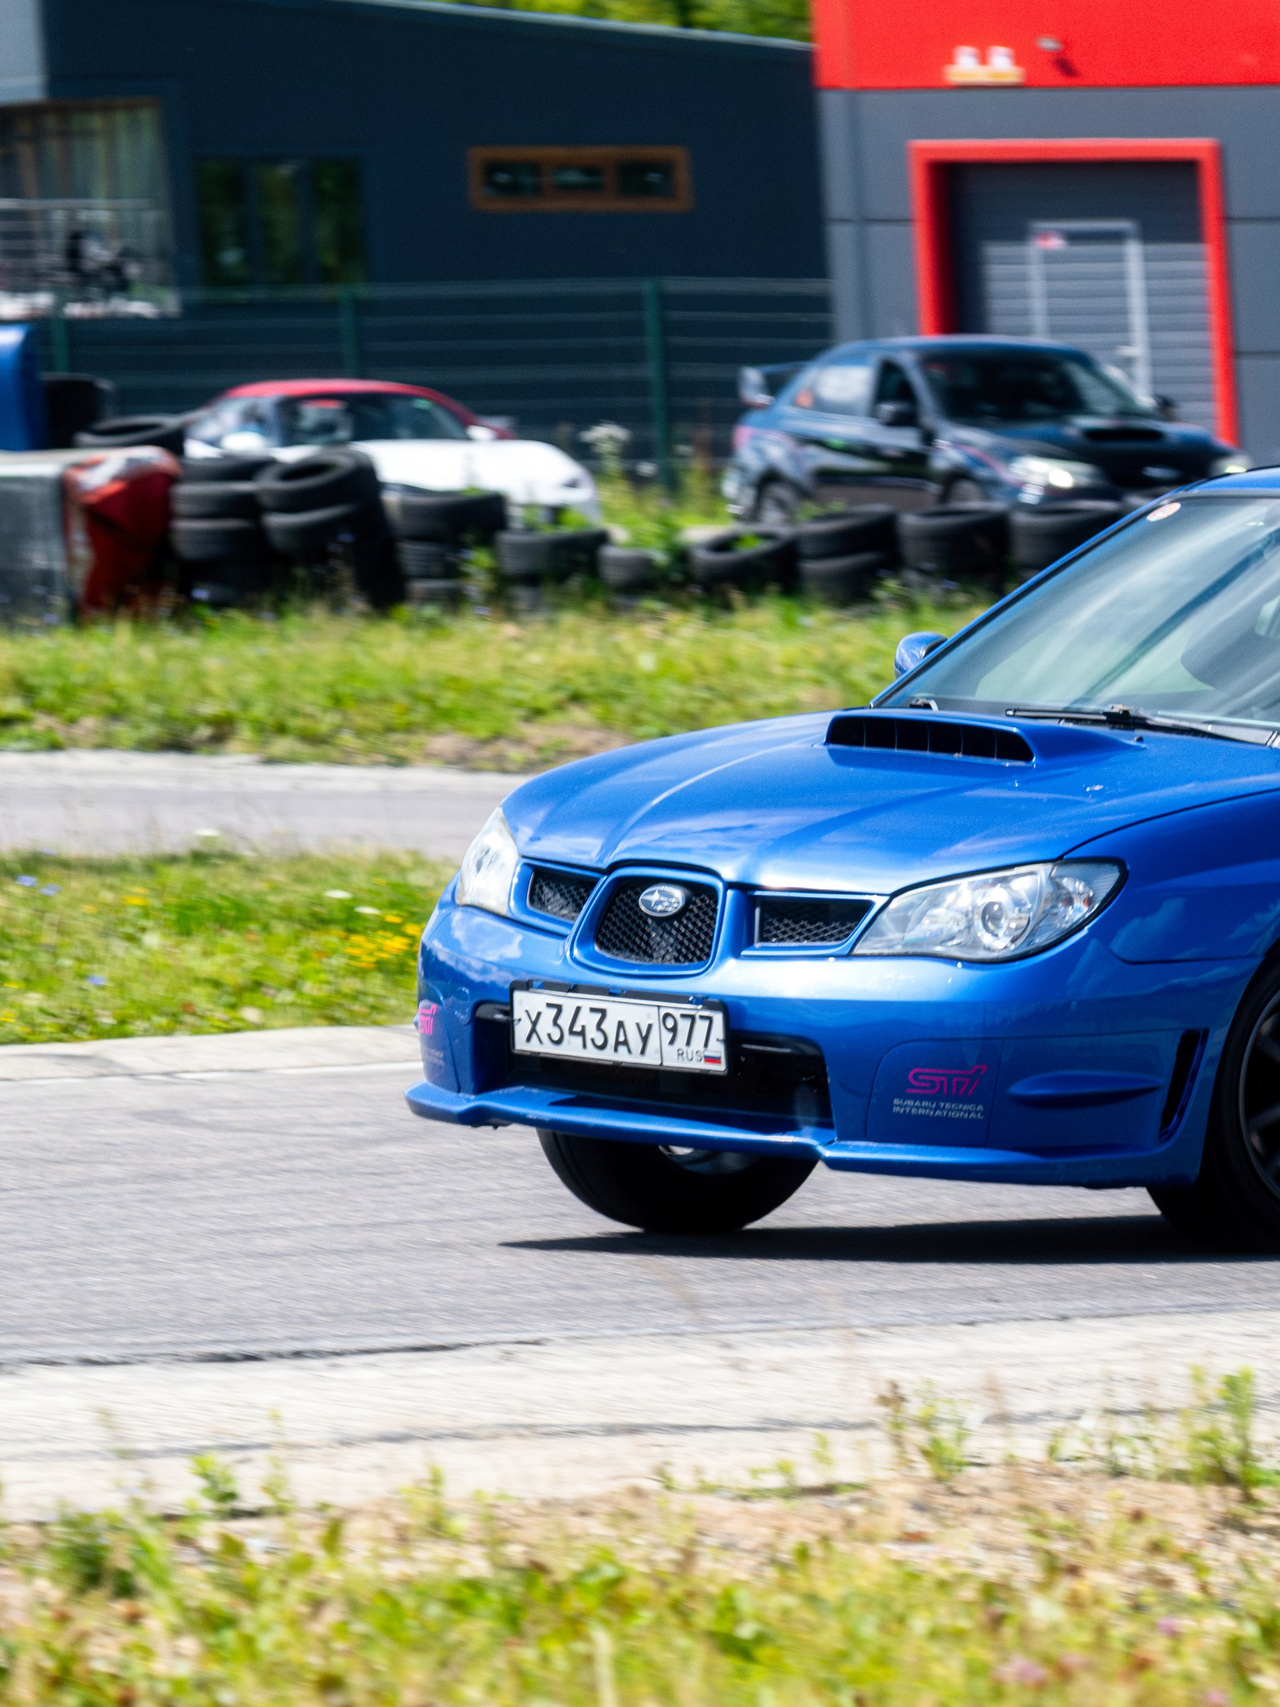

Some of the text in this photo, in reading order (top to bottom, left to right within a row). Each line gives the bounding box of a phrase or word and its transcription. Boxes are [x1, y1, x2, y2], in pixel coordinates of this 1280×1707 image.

[661, 1012, 714, 1049] 977
[676, 1048, 703, 1063] RUS
[893, 1098, 984, 1112] SUBARU TECNICA
[893, 1106, 984, 1120] INTERNATIONAL
